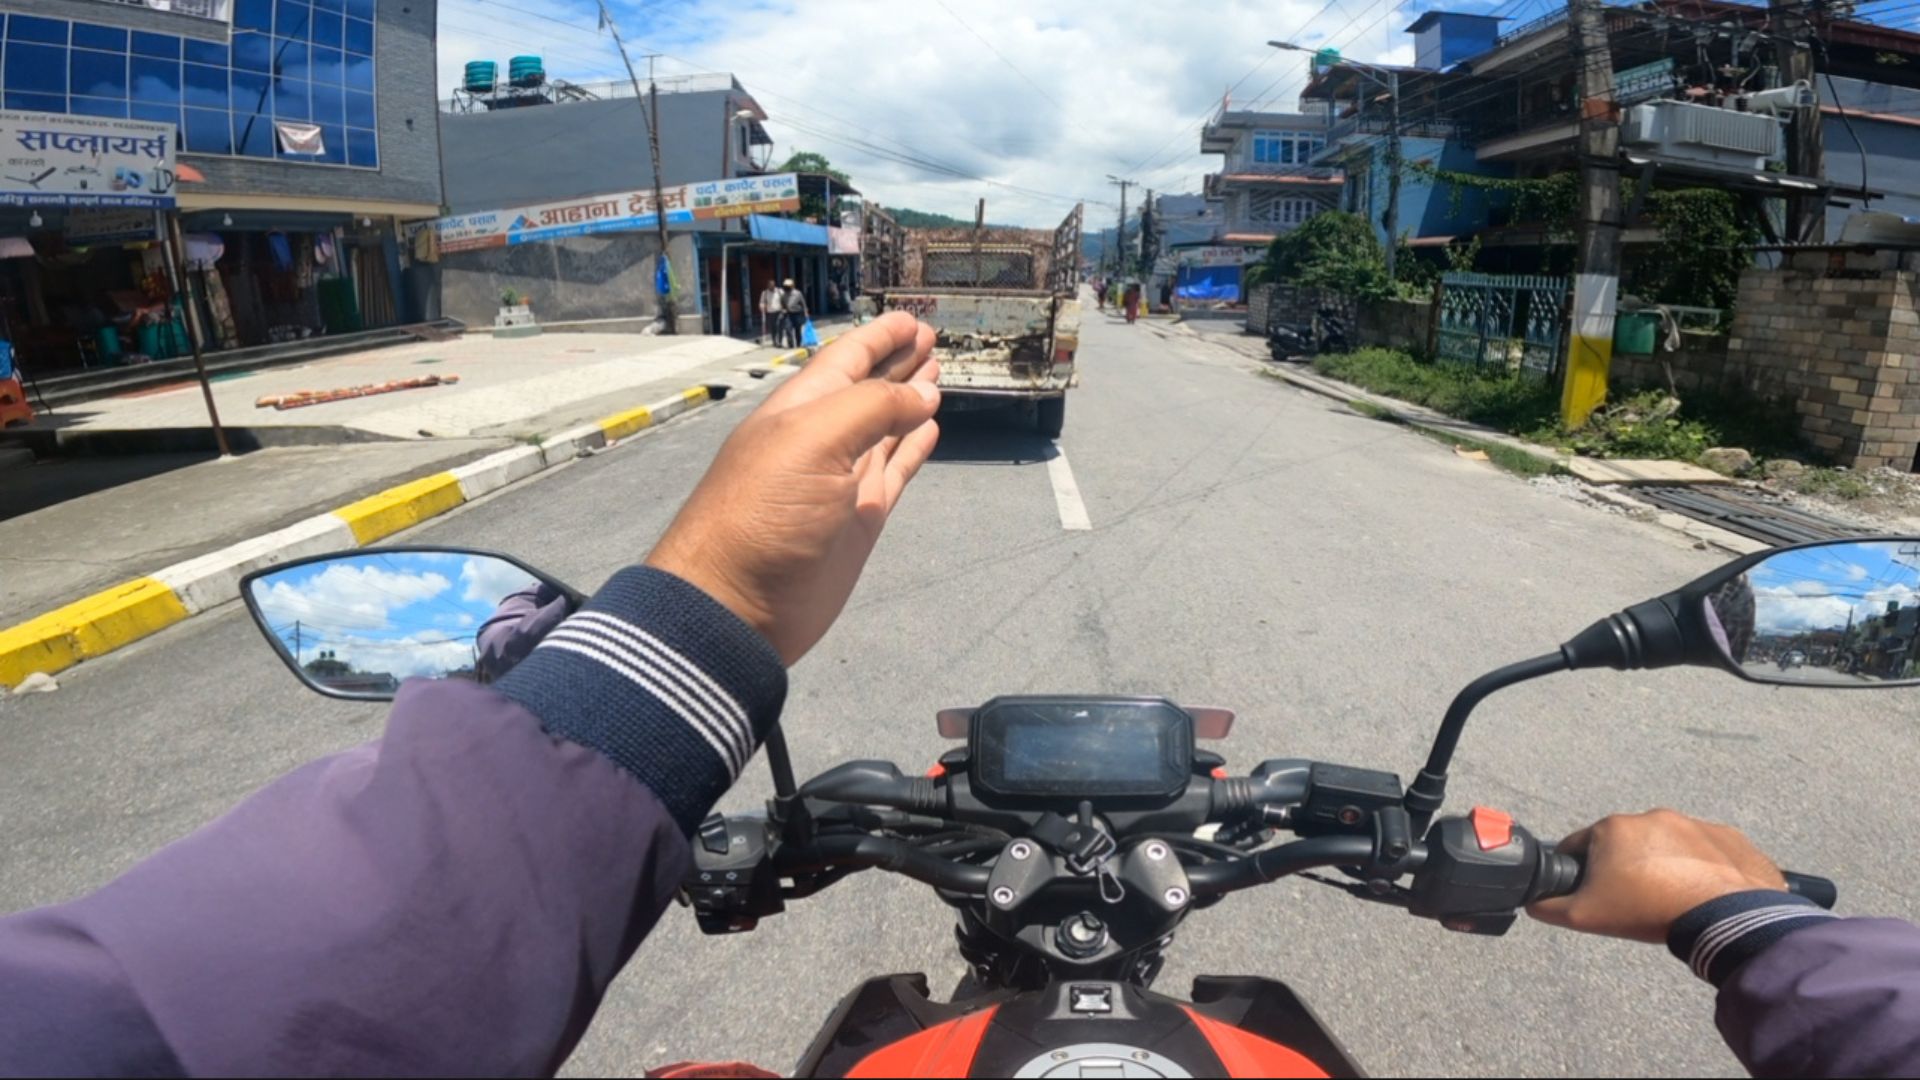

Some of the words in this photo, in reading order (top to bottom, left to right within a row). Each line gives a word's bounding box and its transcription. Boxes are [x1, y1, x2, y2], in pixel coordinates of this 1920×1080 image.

[16, 129, 169, 159] सप्लायर्स
[762, 175, 793, 188] पसल
[540, 201, 619, 226] आहाना
